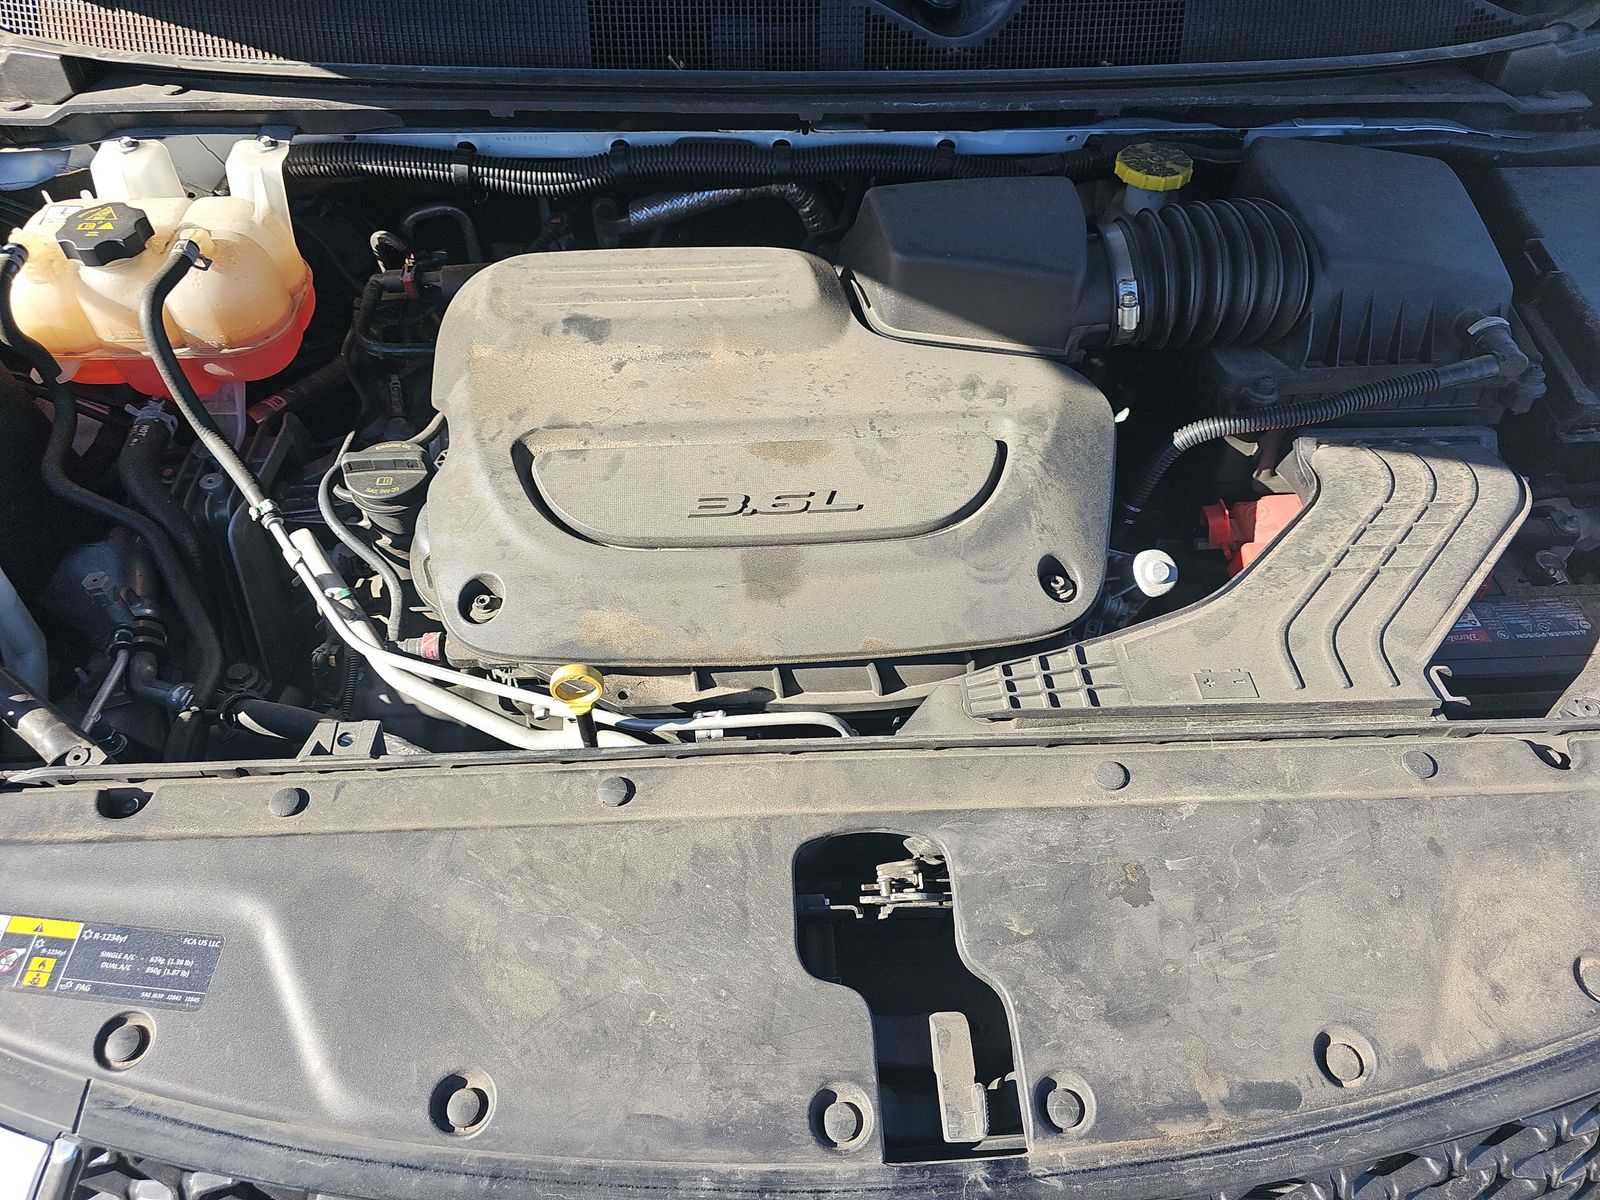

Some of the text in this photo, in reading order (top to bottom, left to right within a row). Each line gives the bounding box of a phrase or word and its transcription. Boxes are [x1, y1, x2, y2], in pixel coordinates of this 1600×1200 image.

[688, 490, 864, 518] 3.6L
[93, 932, 128, 943] R-1234yf
[183, 937, 221, 948] FCA US LLC
[100, 950, 121, 960] SINGLE
[121, 952, 135, 961] A/C
[184, 959, 194, 967] lb)
[101, 961, 118, 970] DUAL
[118, 963, 132, 971] A/C
[180, 970, 190, 978] lb)
[75, 983, 91, 992] PAG
